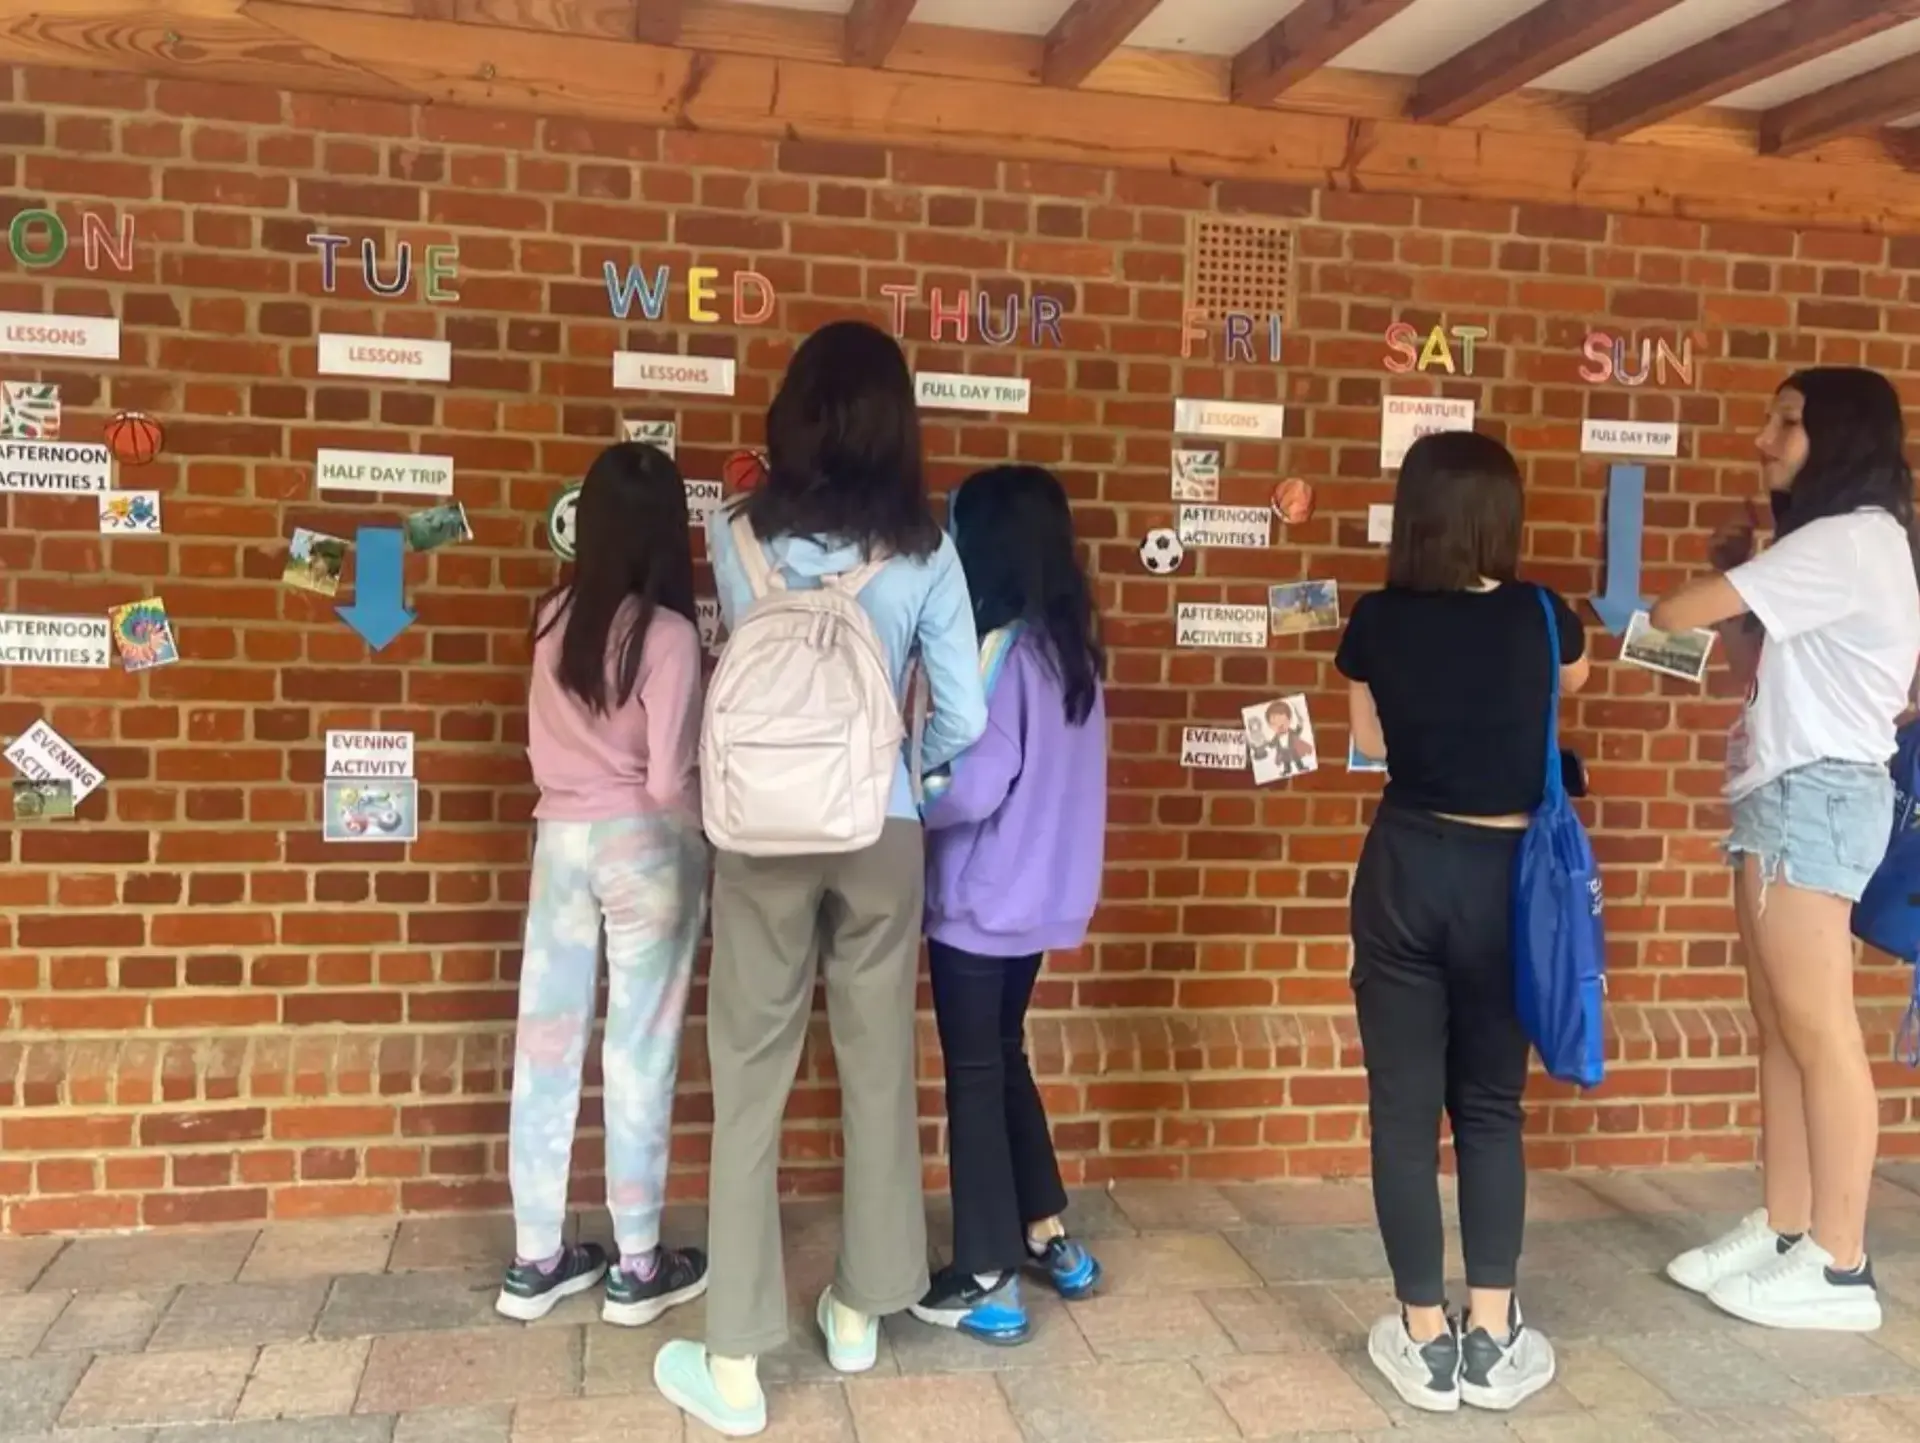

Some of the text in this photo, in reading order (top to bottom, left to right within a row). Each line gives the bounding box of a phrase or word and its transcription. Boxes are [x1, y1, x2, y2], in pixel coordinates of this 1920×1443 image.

[307, 234, 460, 301] TUE
[603, 260, 775, 324] WED
[880, 284, 1063, 346] THUR
[7, 326, 87, 346] LESSONS
[1181, 309, 1281, 363] FRI
[349, 346, 423, 365] LESSONS
[1383, 322, 1488, 375] SAT
[1579, 332, 1692, 386] SUN
[640, 364, 709, 383] LESSONS
[922, 382, 1026, 402] FULL DAY TRIP
[1388, 402, 1466, 418] DEPARTURE
[1200, 412, 1260, 428] LESSONS
[1591, 429, 1672, 445] FULL DAY TRIP
[97, 475, 106, 490] 1
[323, 464, 447, 485] HALF DAY TRIP
[1183, 507, 1268, 523] AFTERNOON
[1184, 530, 1267, 546] ACTIVITIES 1
[1181, 607, 1266, 622] AFTERNOON
[1181, 629, 1265, 644] ACTIVITIES 2
[95, 648, 106, 665] 2
[332, 734, 407, 750] EVENING
[1186, 730, 1246, 745] EVENING
[31, 728, 97, 788] EVENING
[331, 759, 407, 774] ACTIVITY
[1184, 751, 1244, 766] ACTIVITY
